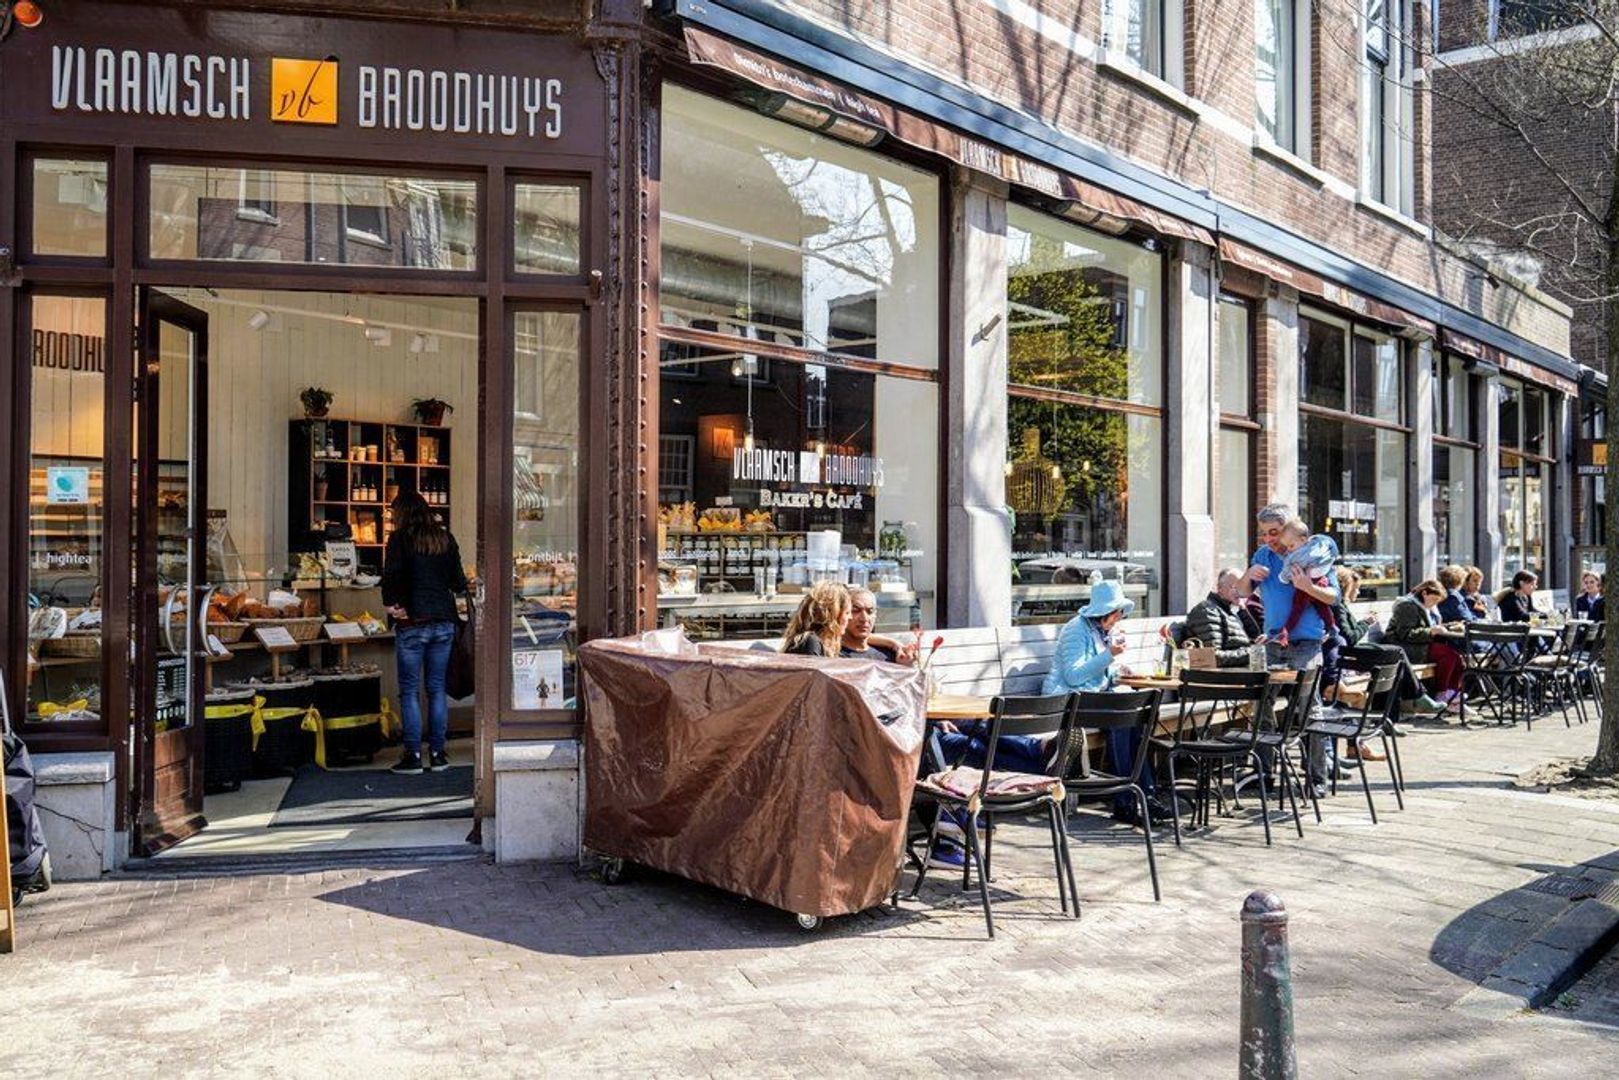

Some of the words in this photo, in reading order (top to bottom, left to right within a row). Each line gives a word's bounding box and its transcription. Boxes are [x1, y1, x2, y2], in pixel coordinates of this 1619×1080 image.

[51, 45, 250, 120] VLAAMSCH
[358, 66, 562, 139] BROODHUYS
[733, 447, 795, 482] VLAAMSCH
[47, 552, 92, 566] hightea
